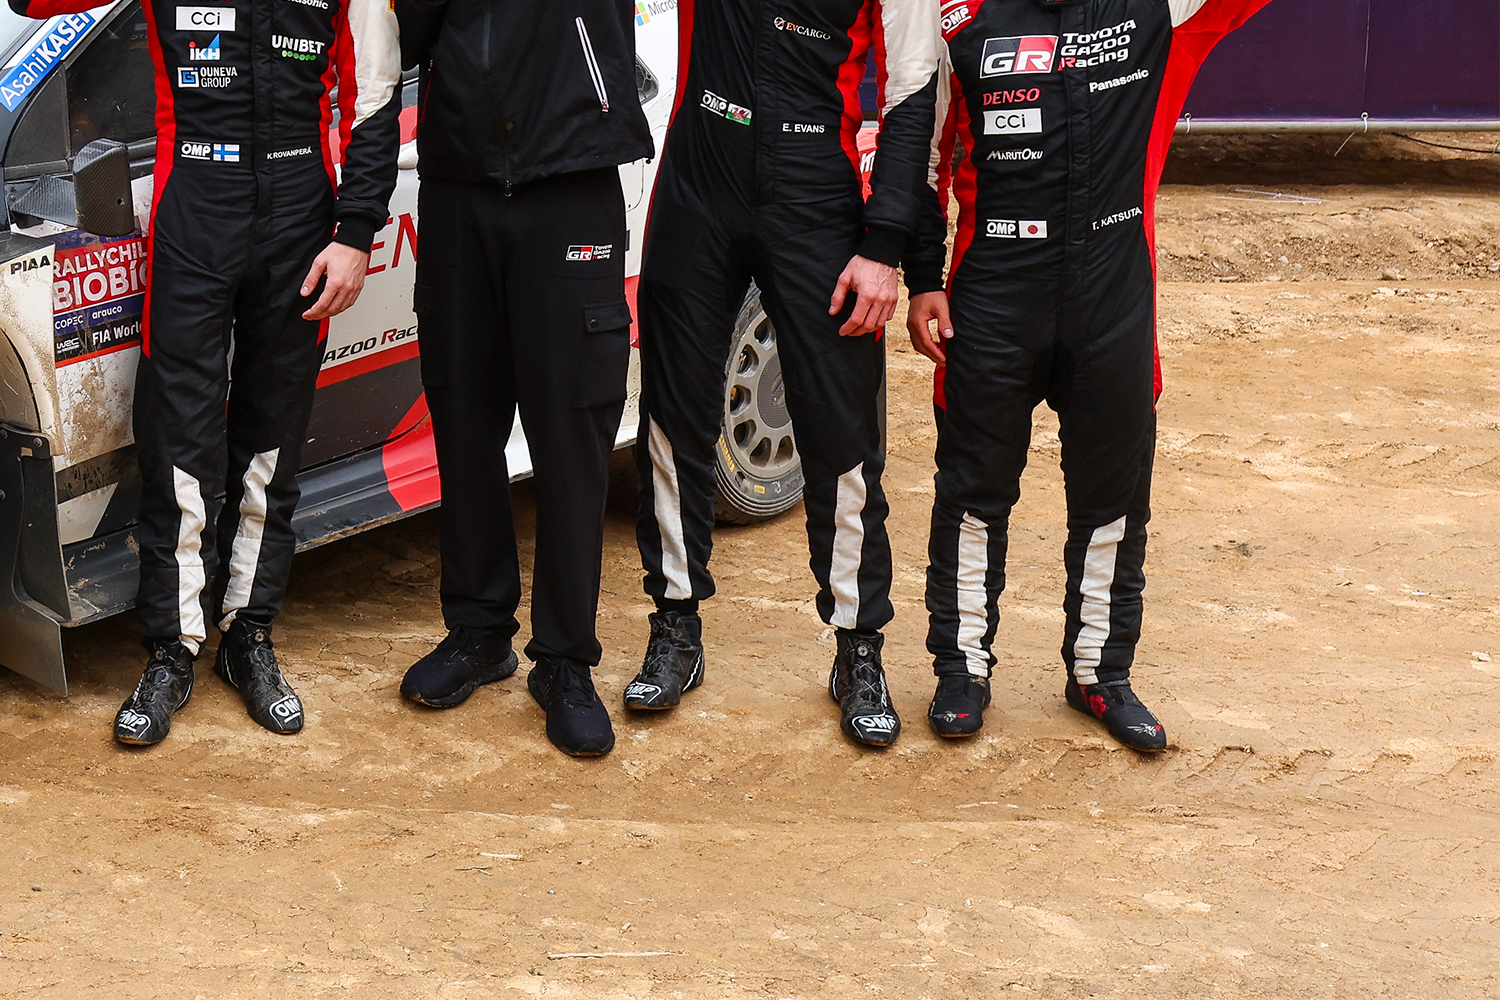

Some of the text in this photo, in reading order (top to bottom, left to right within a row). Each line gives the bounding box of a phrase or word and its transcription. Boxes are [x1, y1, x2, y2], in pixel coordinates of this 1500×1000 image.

[191, 11, 221, 26] CCi
[942, 6, 969, 31] OMP
[1063, 19, 1136, 44] TOYOTA
[272, 34, 325, 55] UNIBET
[1061, 35, 1131, 56] GAZOO
[0, 12, 91, 107] AsahiKASEI
[983, 51, 1051, 74] GR
[1058, 48, 1129, 71] Racing
[200, 66, 238, 77] OUNEVA
[1089, 68, 1149, 93] Panasonic
[200, 77, 231, 88] GROUP
[703, 92, 726, 113] OMP
[983, 88, 1041, 106] DENSO
[783, 123, 825, 133] E. EVANS
[995, 114, 1026, 129] CCi
[181, 143, 211, 157] OMP
[1100, 206, 1143, 227] KATSUTA
[987, 222, 1016, 234] OMP
[53, 241, 148, 279] RALLYCHIL
[569, 251, 590, 260] GR
[10, 254, 51, 276] PIAA
[92, 305, 122, 320] arauco
[54, 315, 83, 330] COPEC
[56, 337, 80, 349] WRC
[92, 329, 112, 346] FIA
